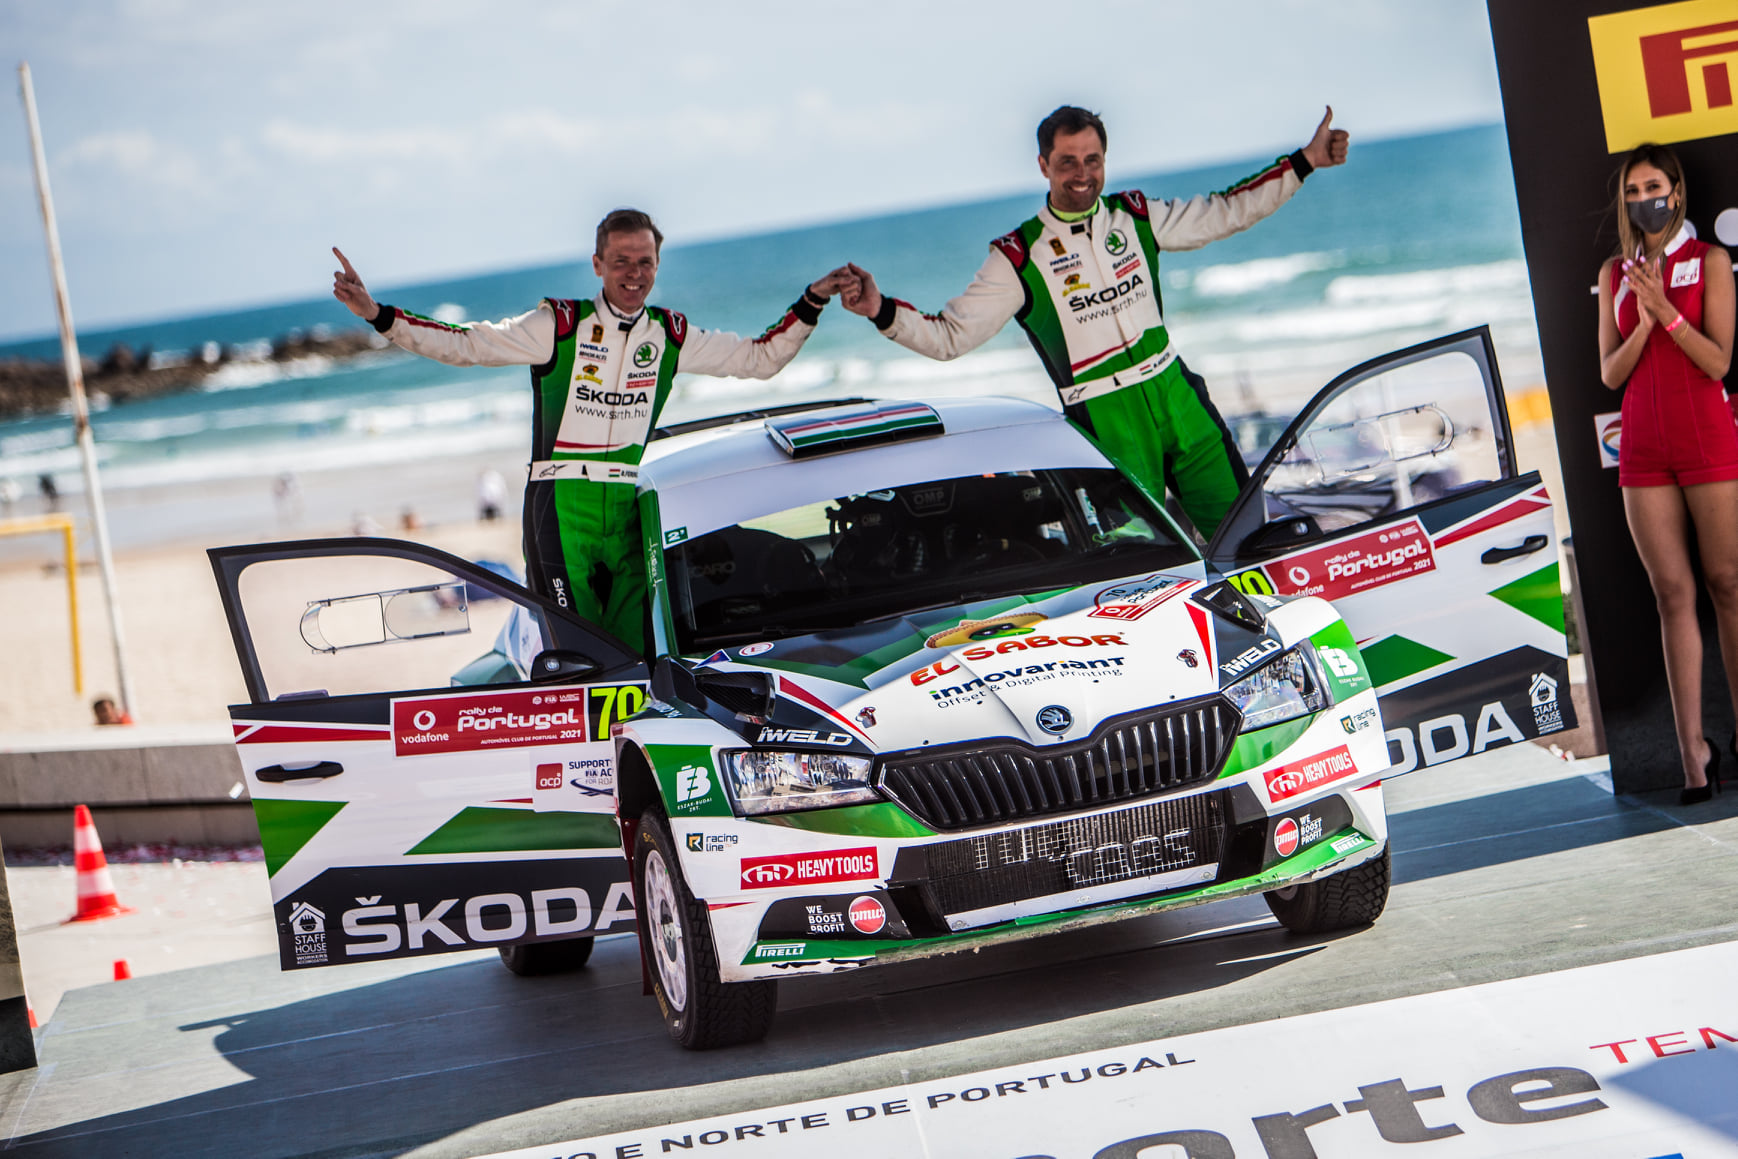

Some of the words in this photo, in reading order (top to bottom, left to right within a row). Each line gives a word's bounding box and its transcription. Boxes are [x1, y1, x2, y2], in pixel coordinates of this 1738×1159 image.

[1069, 273, 1144, 312] ŠKODA
[576, 384, 649, 406] ŠKODA
[1328, 540, 1427, 581] Portugal
[1347, 550, 1360, 560] de
[1413, 559, 1431, 571] 2021
[910, 661, 960, 686] EL
[962, 634, 1129, 661] SABOR
[1219, 638, 1282, 677] iWELD
[937, 690, 987, 709] Offset
[1005, 672, 1055, 688] Digital
[1061, 667, 1123, 679] Printing
[458, 707, 487, 716] rally
[488, 706, 502, 714] de
[591, 685, 644, 740] 70
[1533, 701, 1559, 717] STAFF
[457, 709, 579, 732] Portugal
[1534, 710, 1562, 725] HOUSE
[401, 732, 449, 745] vodafone
[560, 729, 582, 739] 2021
[757, 726, 853, 746] iWELD
[585, 769, 598, 777] FIA
[1302, 758, 1330, 783] HEAVY
[1328, 751, 1353, 774] TOOLS
[540, 776, 561, 788] acp
[585, 777, 597, 785] FOR
[1299, 813, 1311, 826] WE
[1300, 817, 1322, 836] BOOST
[706, 833, 738, 844] racing
[1301, 829, 1322, 846] PROFIT
[1330, 832, 1366, 855] PIRELLI
[706, 843, 724, 852] line
[797, 857, 838, 879] HEAVY
[837, 854, 874, 875] TOOLS
[806, 905, 823, 914] WE
[341, 881, 636, 956] ŠKODA
[808, 913, 843, 924] BOOST
[810, 923, 845, 934] PROFIT
[294, 933, 326, 945] STAFF
[295, 943, 327, 954] HOUSE
[755, 943, 806, 957] PIRELLI
[661, 1112, 830, 1153] NORTE
[846, 1099, 912, 1122] DE
[927, 1052, 1197, 1110] PORTUGAL
